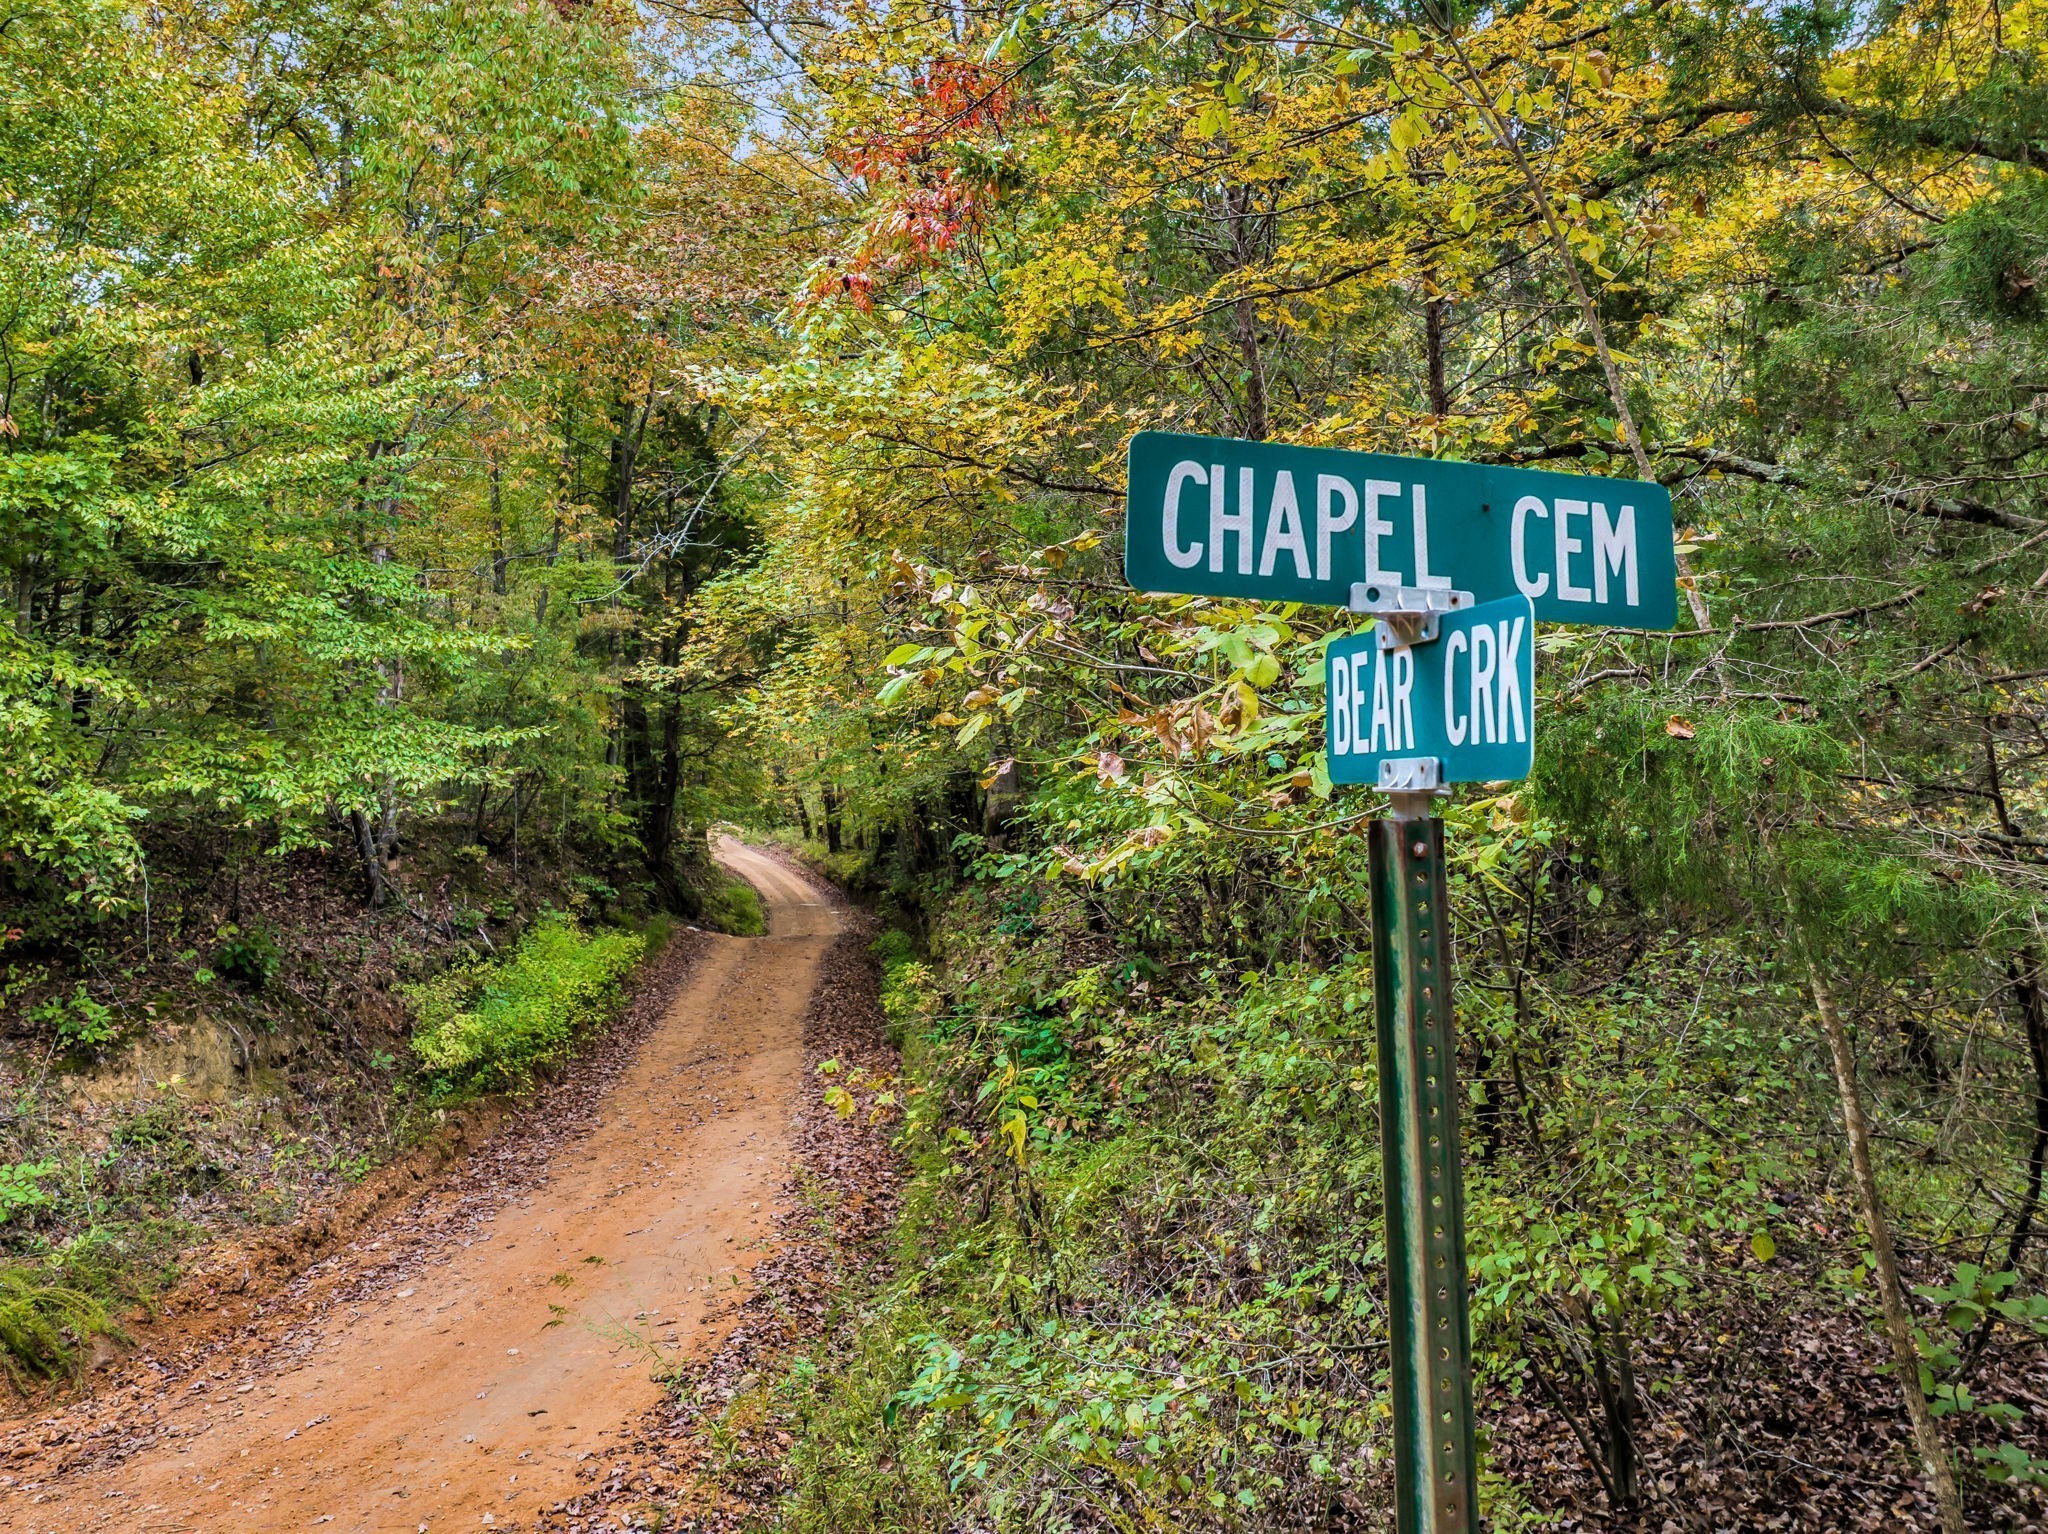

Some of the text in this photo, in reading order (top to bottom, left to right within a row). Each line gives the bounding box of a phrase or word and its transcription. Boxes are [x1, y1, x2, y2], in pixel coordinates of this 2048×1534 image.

[1162, 459, 1639, 607] CHAPEL CEM
[1332, 616, 1526, 756] BEAR CRK
